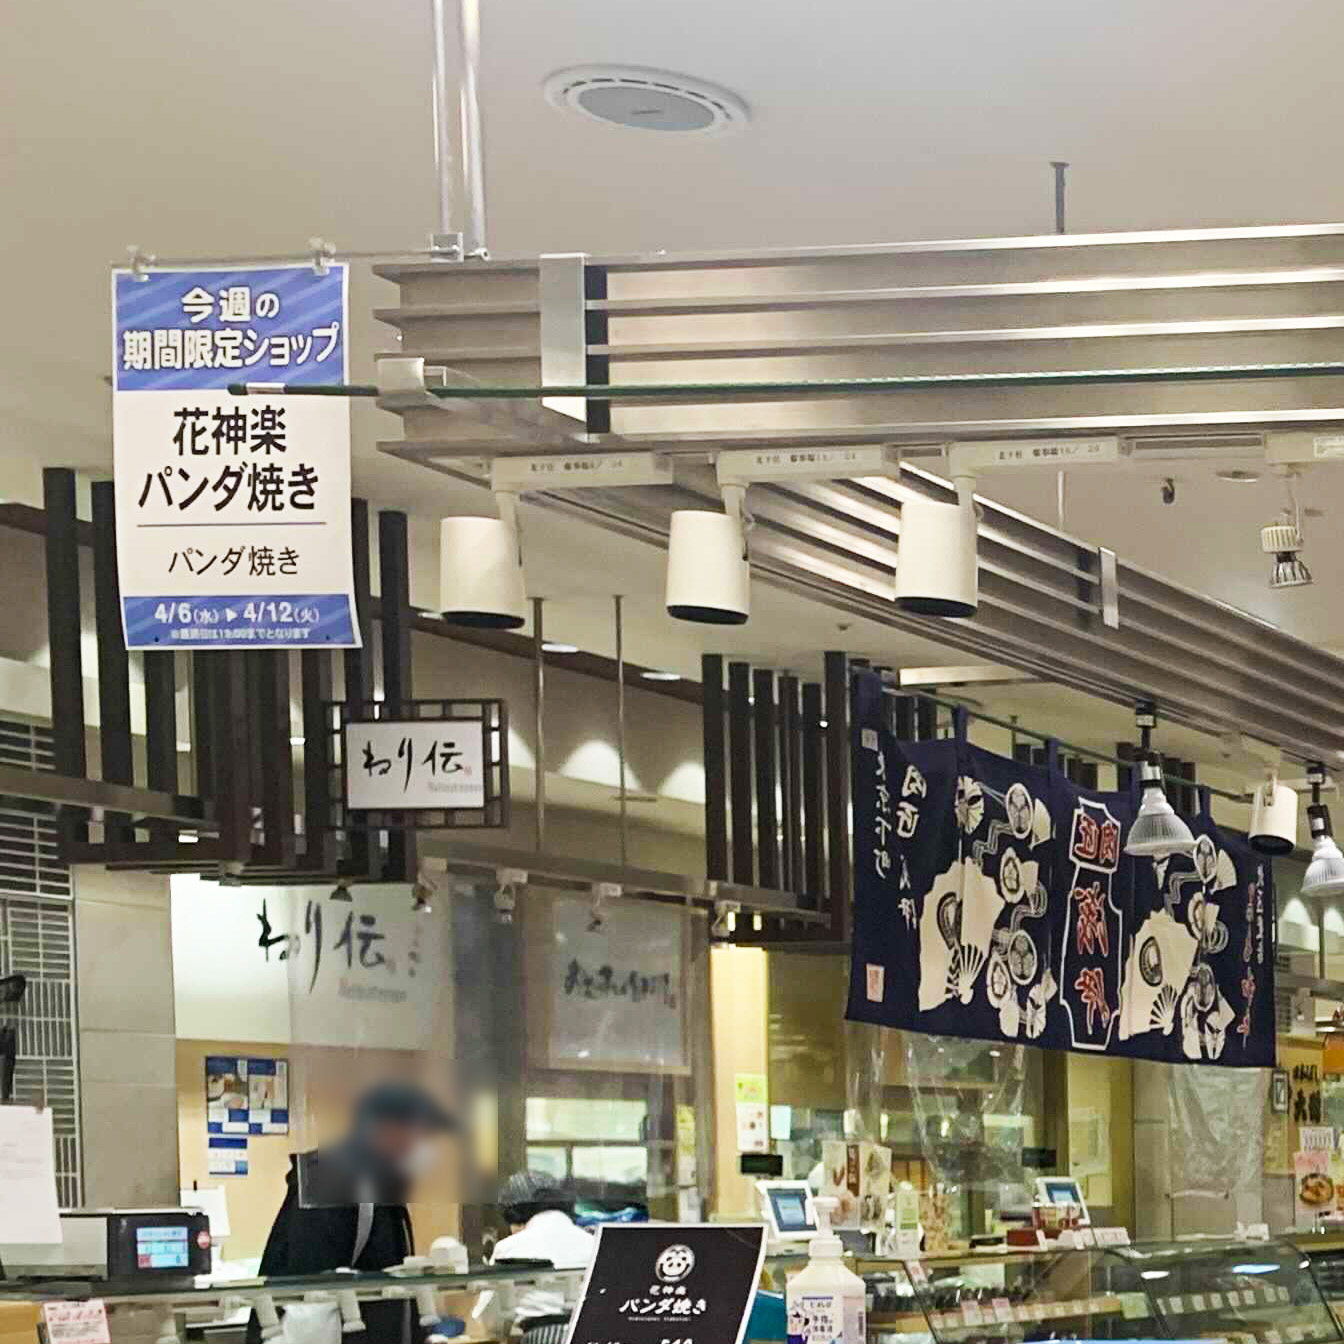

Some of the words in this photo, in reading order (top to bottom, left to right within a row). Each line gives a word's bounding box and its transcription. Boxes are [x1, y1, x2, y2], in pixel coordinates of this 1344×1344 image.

[180, 285, 281, 325] 今週の
[122, 321, 341, 371] 期間限定ショップ
[172, 404, 288, 457] 花神楽
[137, 460, 320, 513] パンダ焼き
[167, 545, 301, 577] パンダ焼き
[618, 1297, 707, 1316] パンダ焼き
